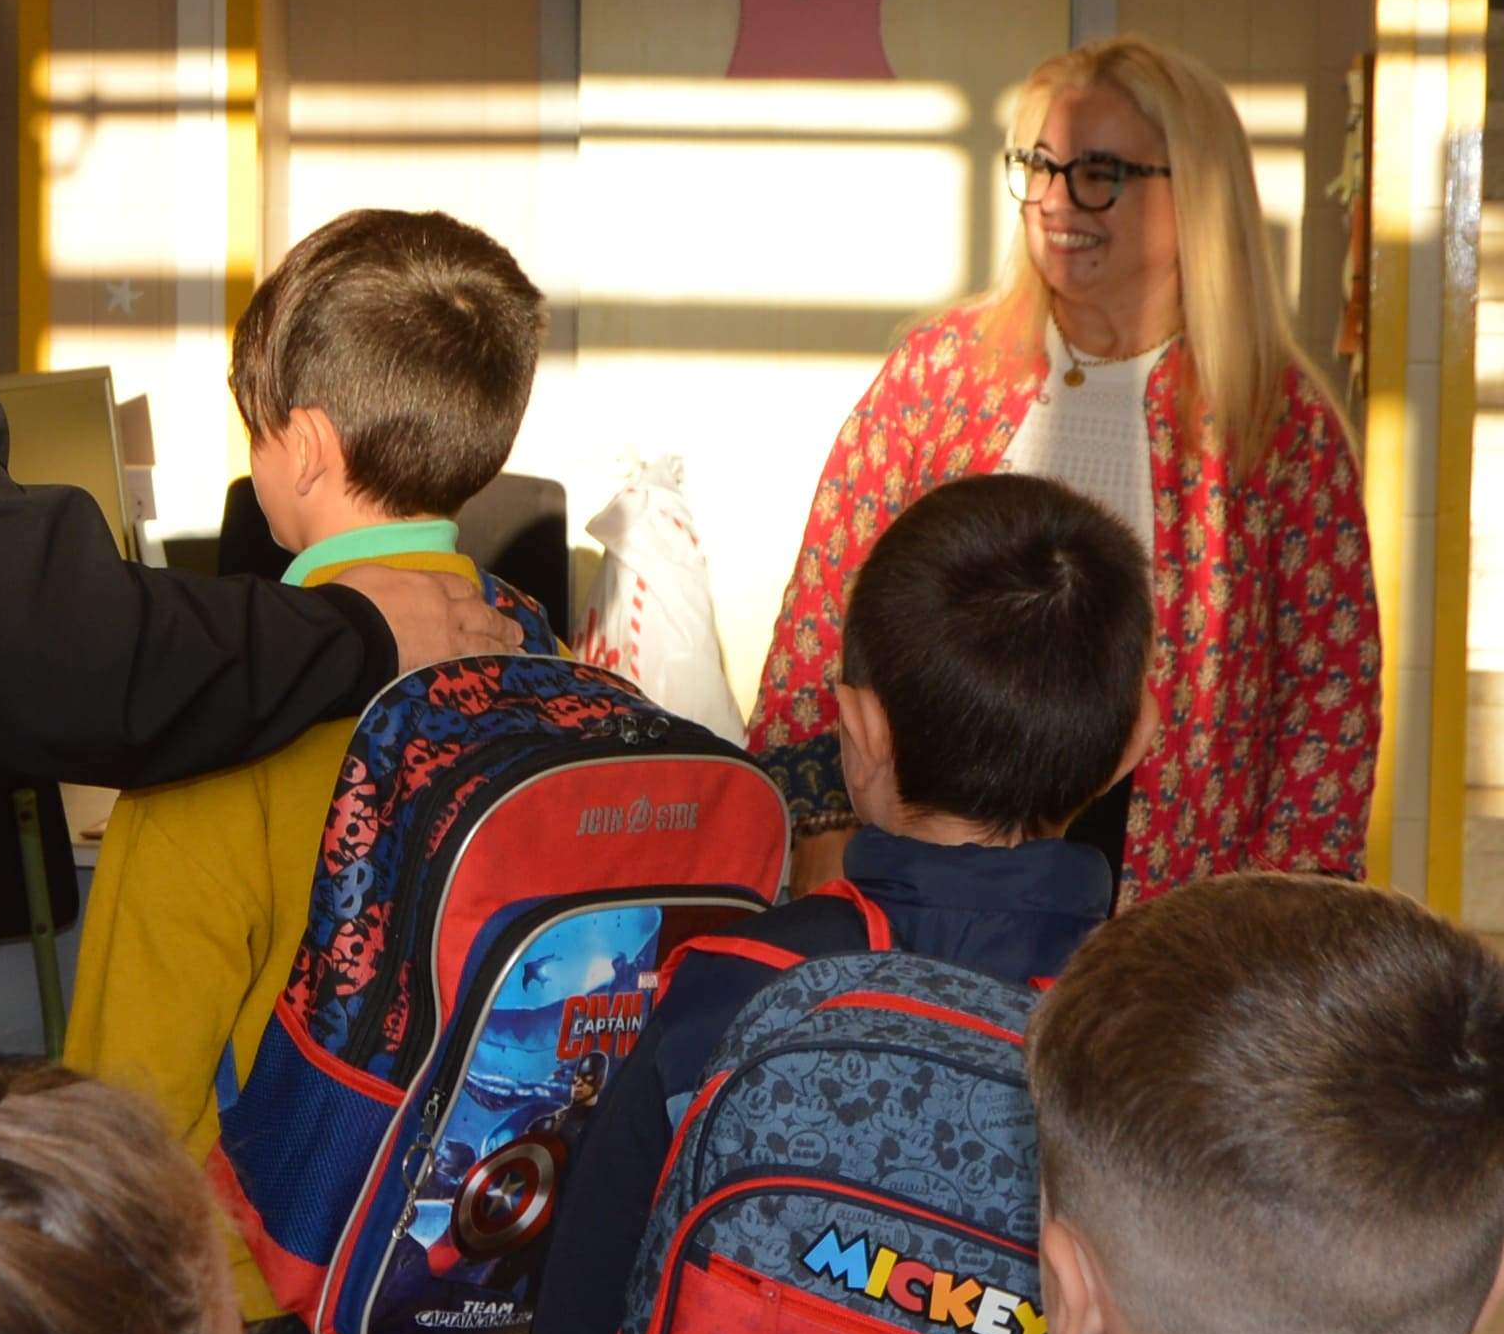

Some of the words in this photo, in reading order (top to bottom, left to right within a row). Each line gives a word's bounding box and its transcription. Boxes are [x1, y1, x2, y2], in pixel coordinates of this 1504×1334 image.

[576, 807, 624, 836] JOIN
[656, 802, 699, 832] SIDE
[573, 1016, 643, 1035] CAPTAIN
[462, 1300, 514, 1314] TEAM
